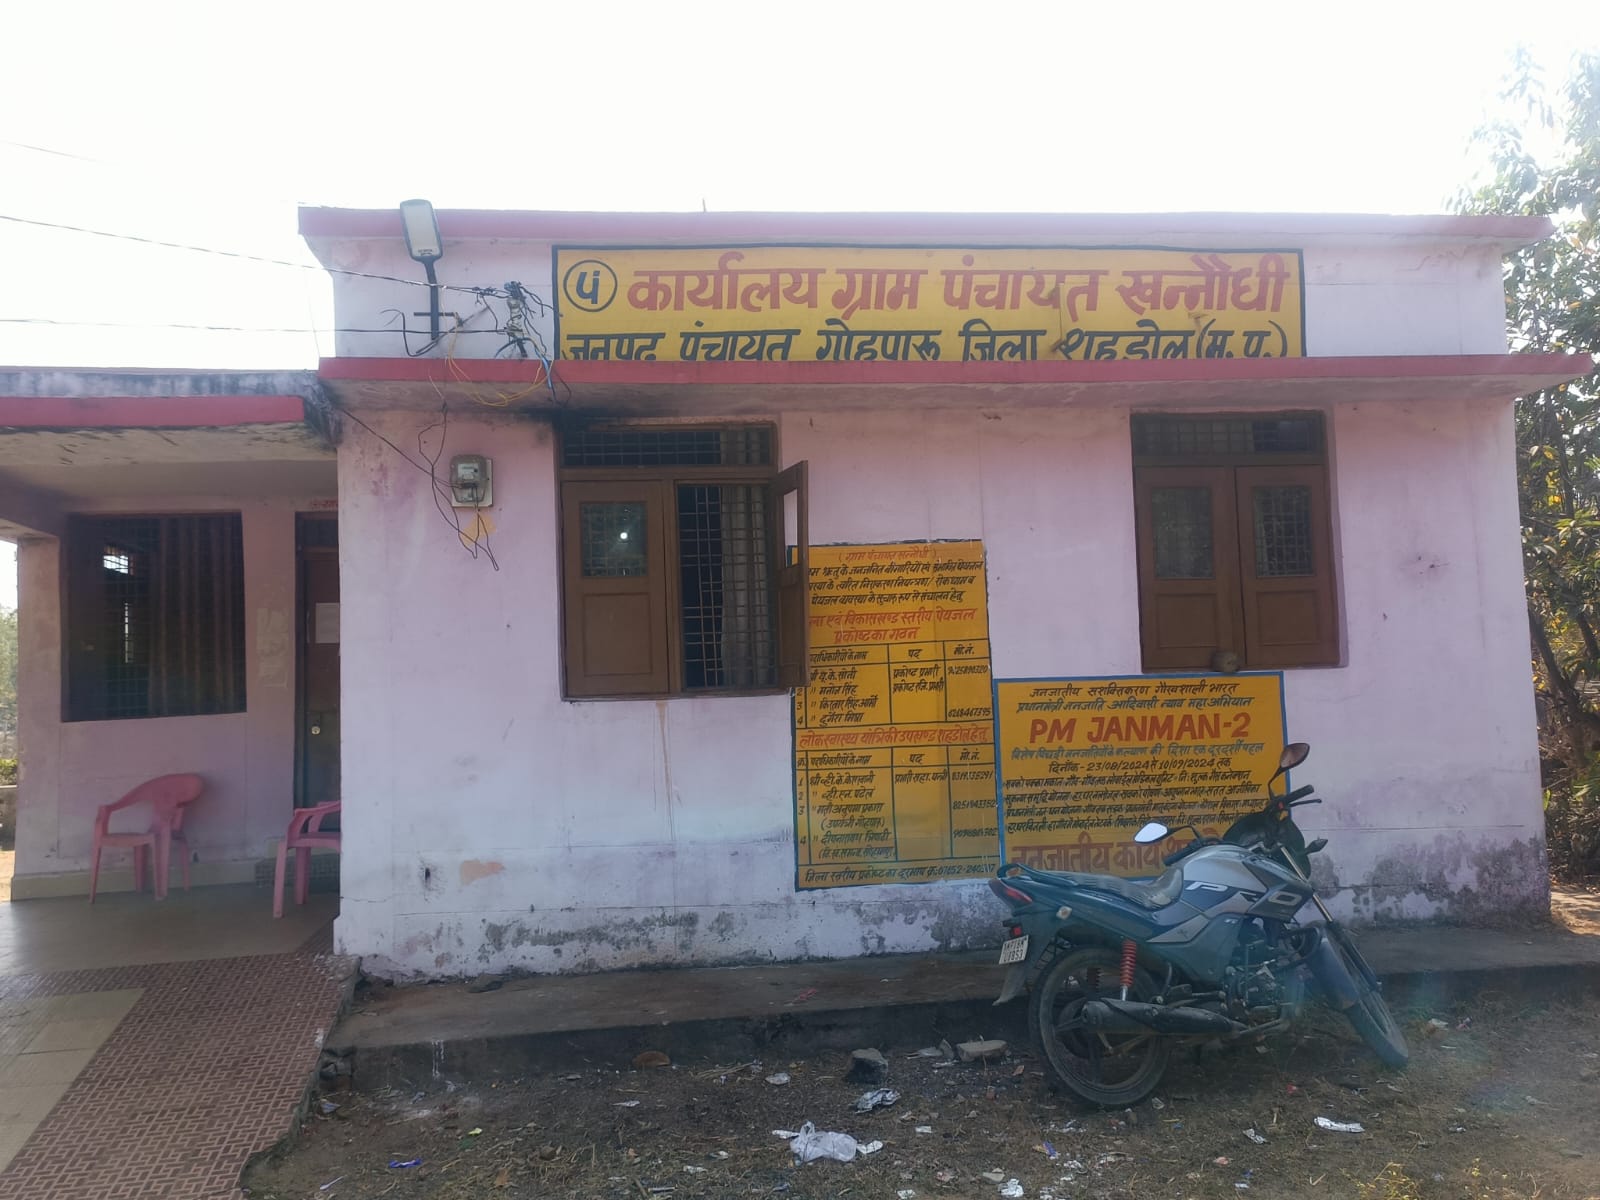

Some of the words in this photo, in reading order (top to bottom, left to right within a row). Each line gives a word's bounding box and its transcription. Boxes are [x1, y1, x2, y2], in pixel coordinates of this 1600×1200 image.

[576, 270, 600, 304] पं
[627, 251, 827, 312] कार्यालय
[832, 268, 929, 320] ग्राम
[940, 254, 1110, 322] पंचायत
[1115, 253, 1291, 316] खन्नौधी
[564, 331, 666, 361] जनपद
[680, 320, 802, 361] पंचायत
[815, 318, 943, 361] गोहपारू
[958, 318, 1047, 361] जिला
[1057, 319, 1195, 361] शहडोल
[908, 648, 923, 660] पद
[1029, 682, 1084, 698] जनजातीय
[1208, 683, 1241, 695] भारत
[1029, 718, 1077, 744] PM
[1086, 711, 1251, 743] JANMAN-2
[909, 753, 925, 764] पद
[1086, 760, 1150, 773] 23/08/2024
